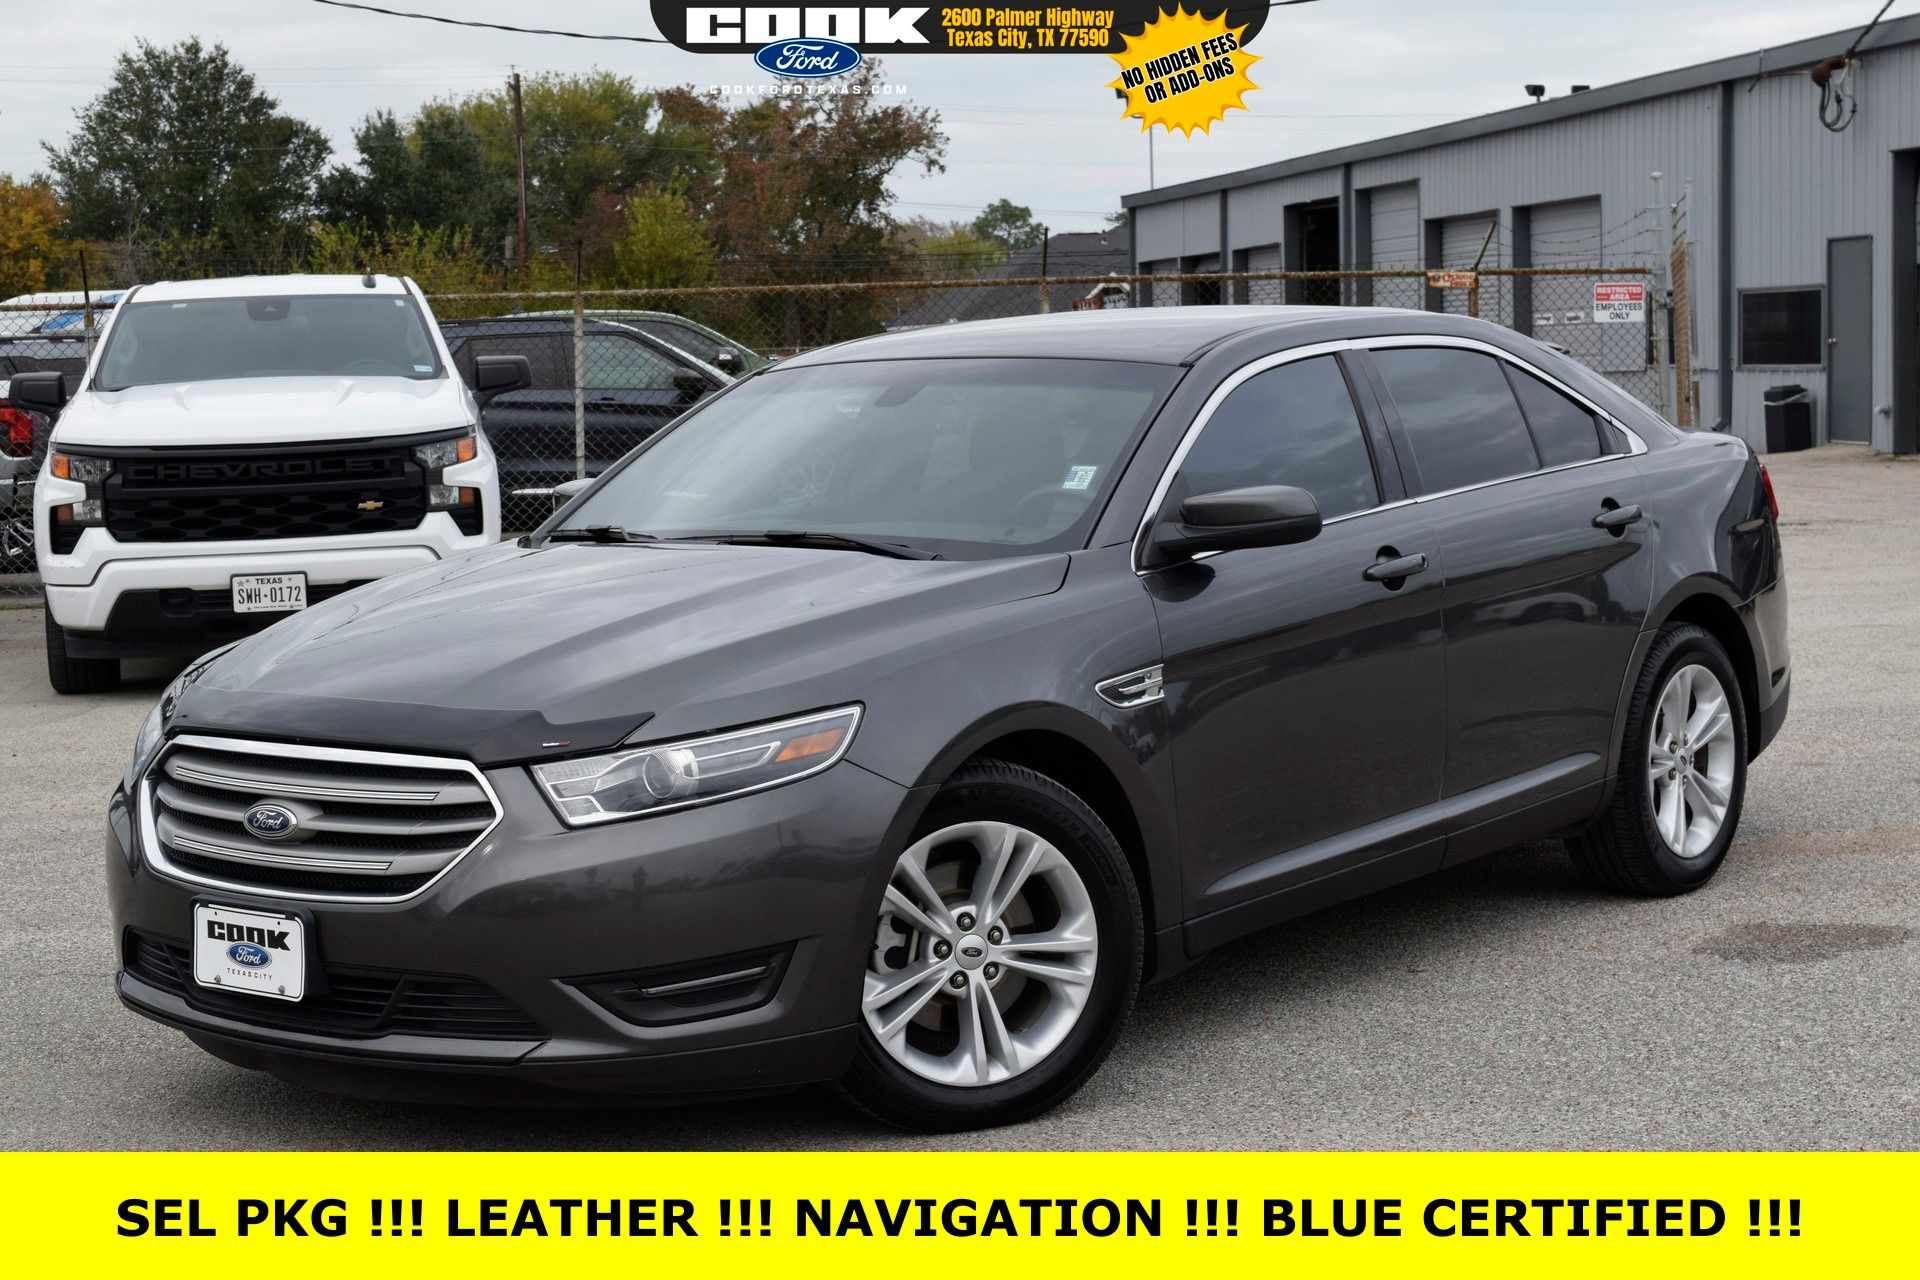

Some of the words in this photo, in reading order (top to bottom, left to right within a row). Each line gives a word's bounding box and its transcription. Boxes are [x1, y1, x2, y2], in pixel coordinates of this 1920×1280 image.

[1596, 286, 1642, 294] RESTRICTED
[1595, 303, 1643, 311] EMPLOYEES
[1609, 312, 1630, 320] ONLY
[127, 454, 400, 480] CHEVROLET
[255, 577, 283, 585] TEXAS
[253, 810, 283, 829] Ford
[207, 920, 291, 951] COOK
[236, 946, 261, 964] Ford
[227, 967, 252, 978] TEXAS
[253, 971, 273, 981] CITY
